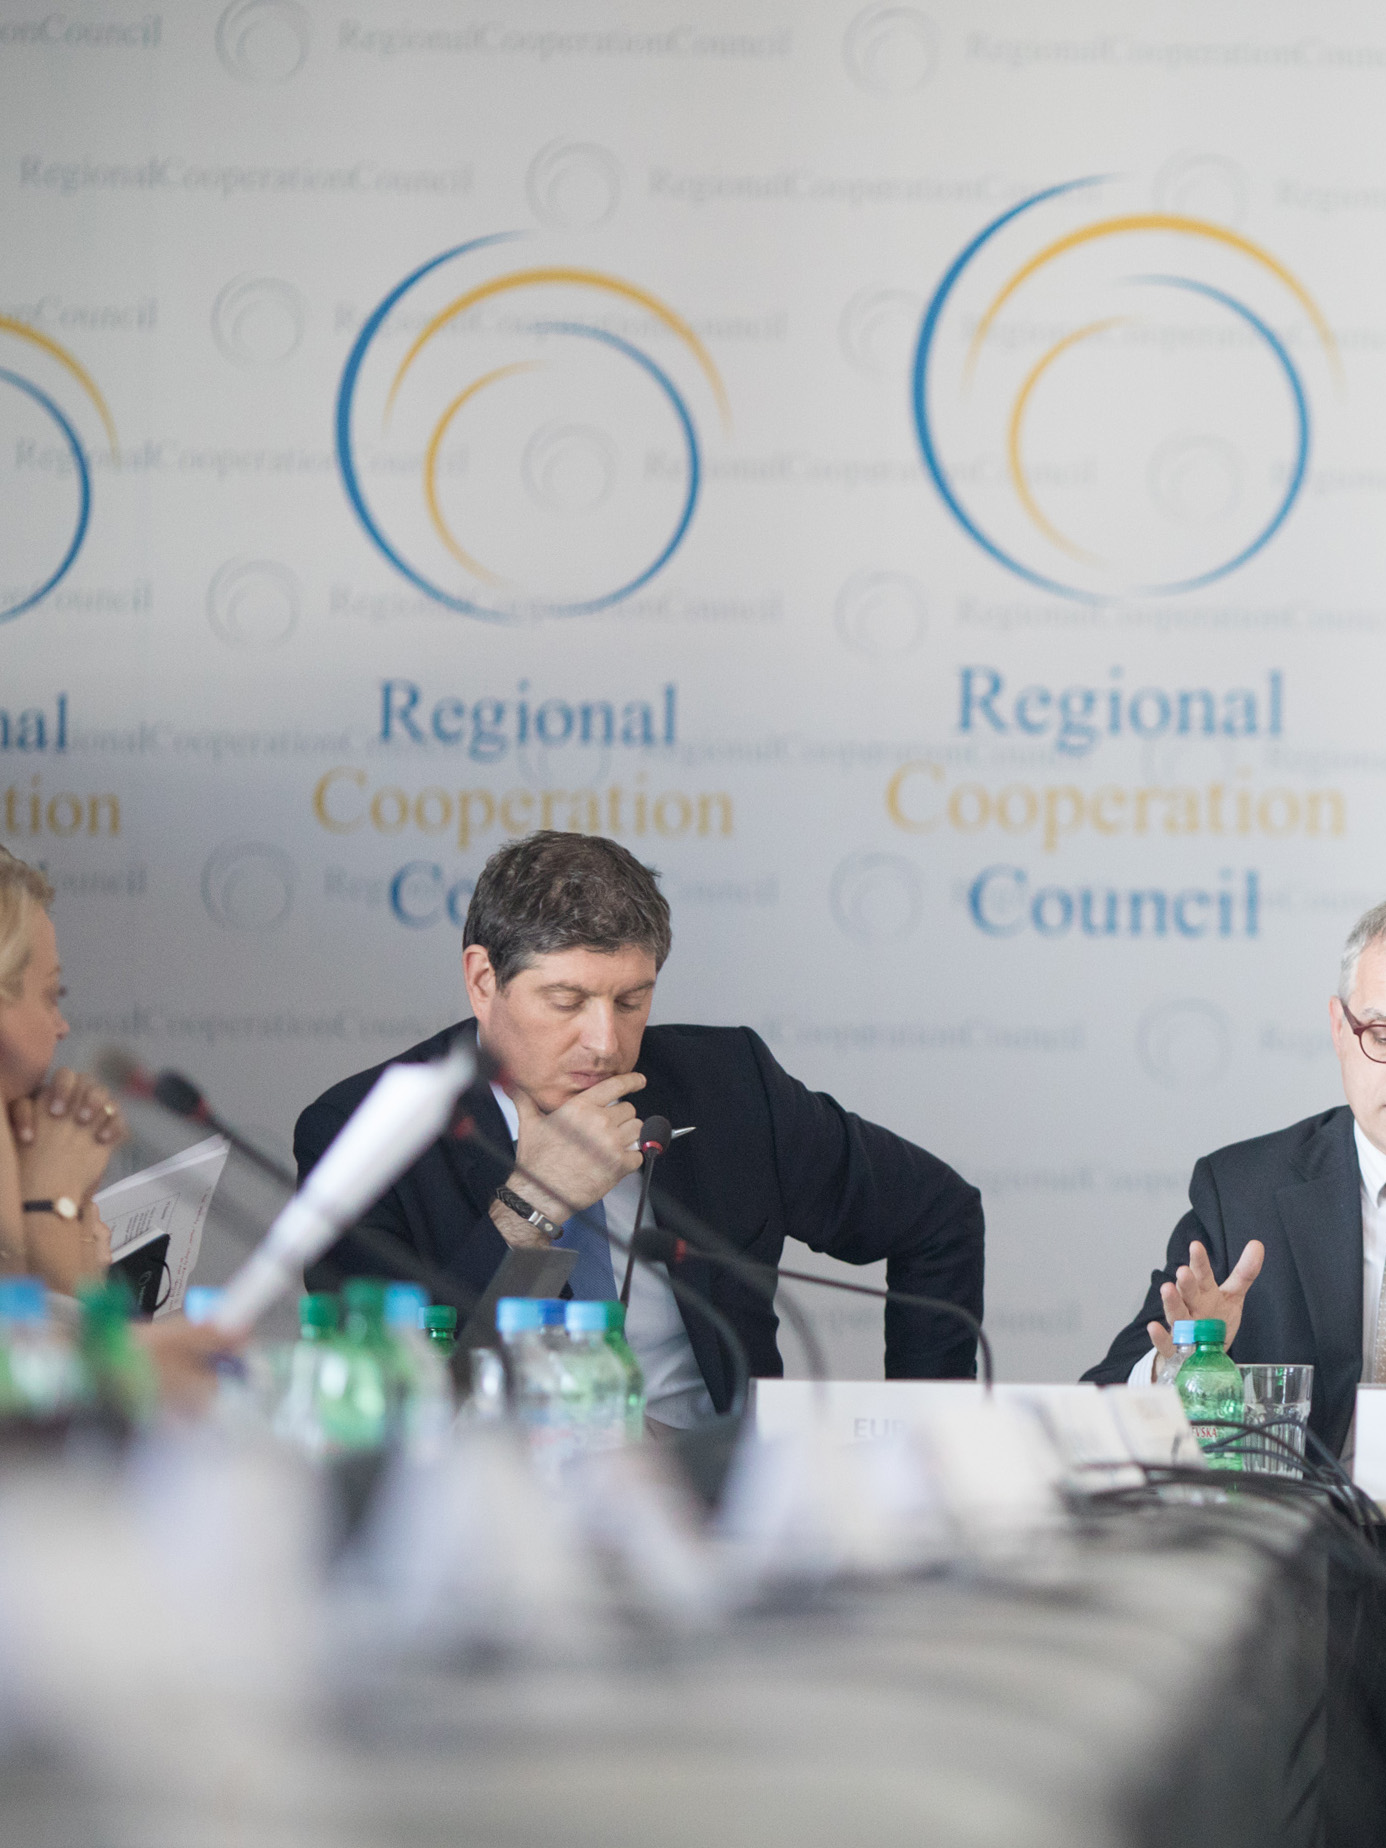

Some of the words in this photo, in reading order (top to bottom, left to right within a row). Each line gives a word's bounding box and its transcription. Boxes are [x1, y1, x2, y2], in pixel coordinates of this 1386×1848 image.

[379, 680, 676, 763] Regional
[958, 667, 1283, 757] Regional
[311, 767, 734, 851] Cooperation
[884, 763, 1347, 854] Cooperation
[966, 866, 1260, 939] Council
